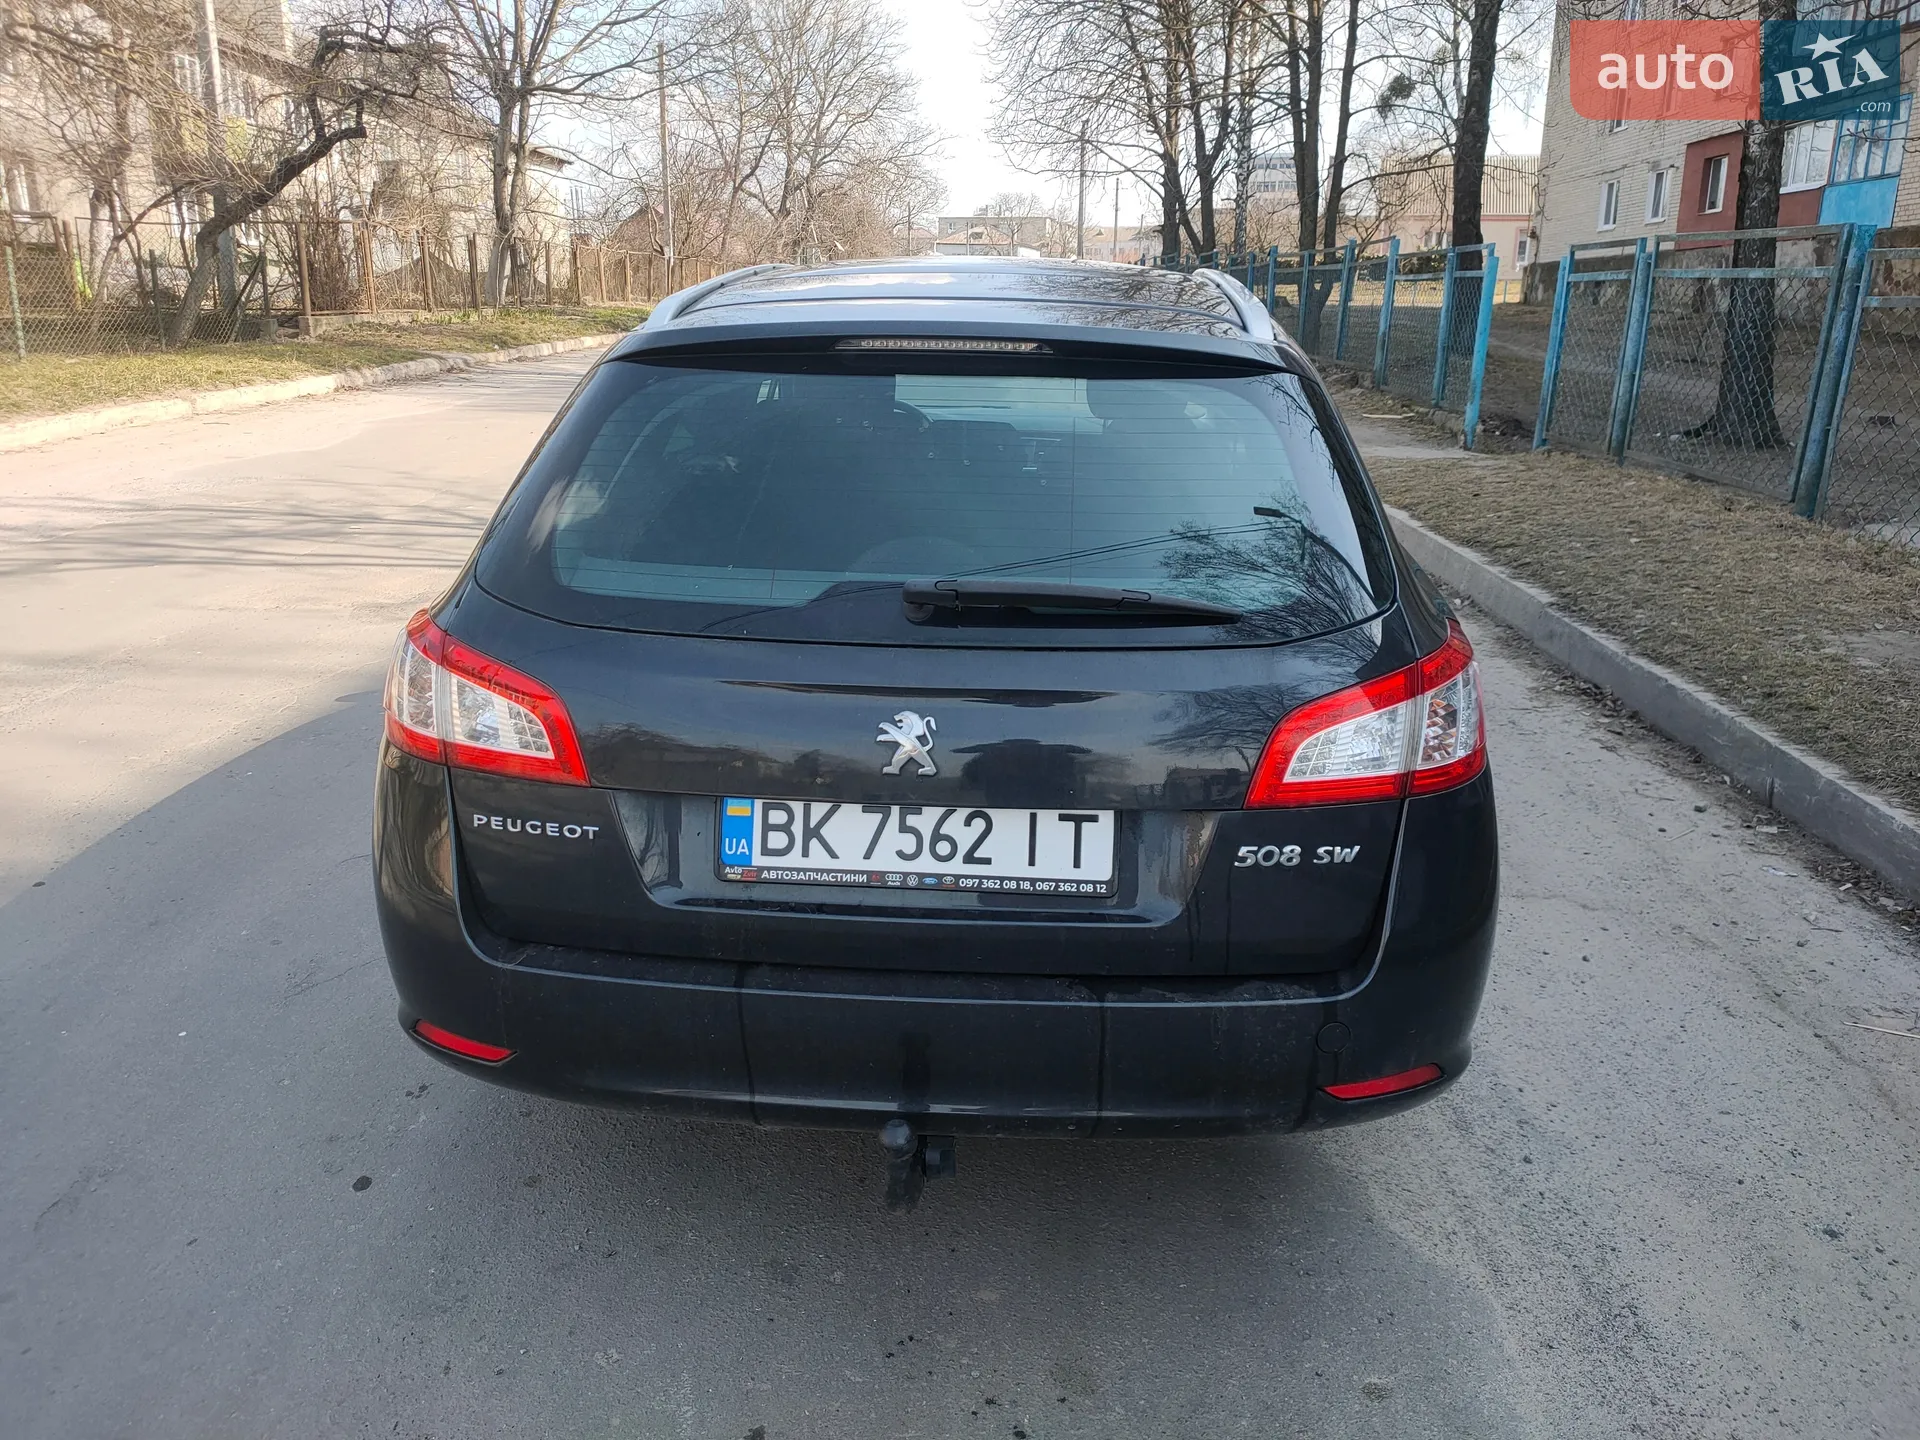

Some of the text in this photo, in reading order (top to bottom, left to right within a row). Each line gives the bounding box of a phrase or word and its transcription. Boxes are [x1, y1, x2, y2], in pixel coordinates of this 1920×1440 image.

[473, 814, 600, 840] PEUGEOT
[760, 801, 1100, 870] BK 7562 IT
[725, 838, 750, 856] UA
[1234, 845, 1361, 868] 508 SW
[761, 870, 867, 883] АВТОЗАПЧАСТИНИ
[959, 878, 1107, 893] 097 362 08 18, 067 362 08 12
